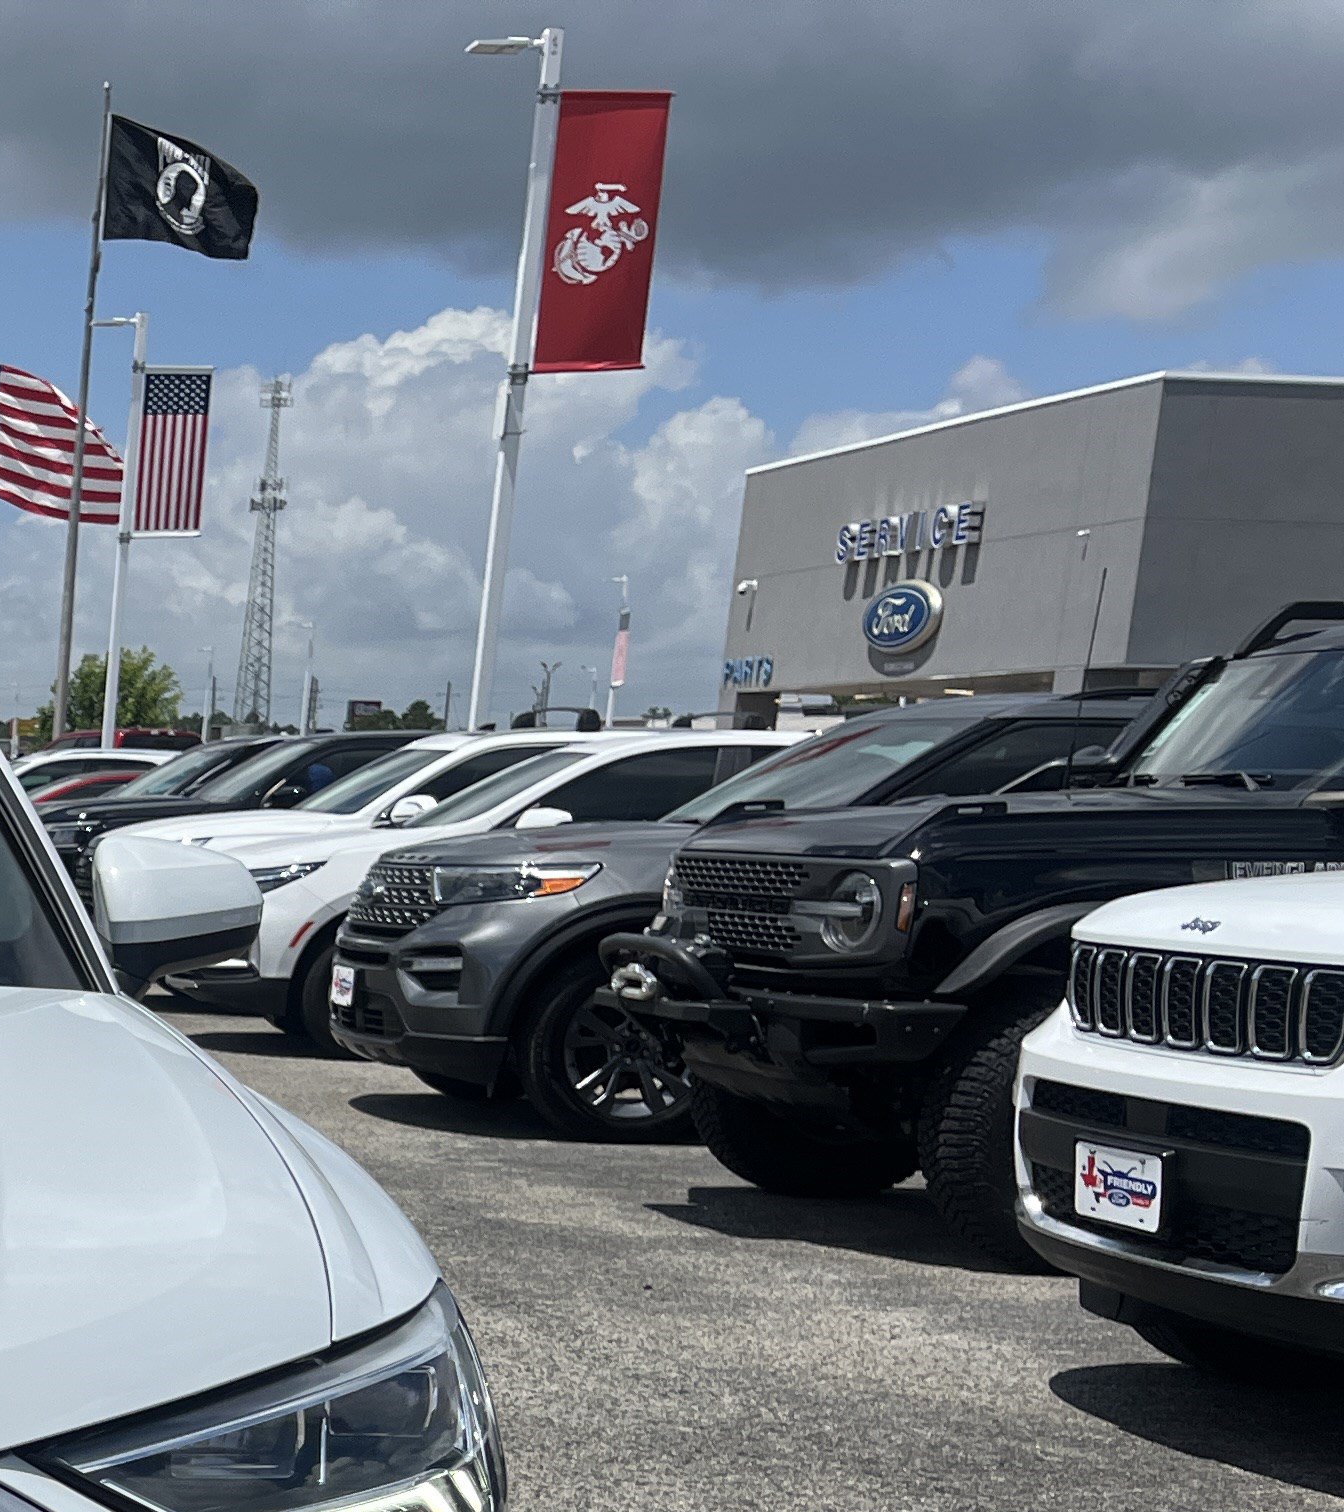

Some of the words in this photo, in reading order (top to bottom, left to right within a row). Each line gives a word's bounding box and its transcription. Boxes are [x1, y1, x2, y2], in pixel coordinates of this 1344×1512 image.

[835, 500, 976, 565] SERVICE
[872, 597, 915, 635] Ford
[1107, 1176, 1153, 1196] FRIENDLY
